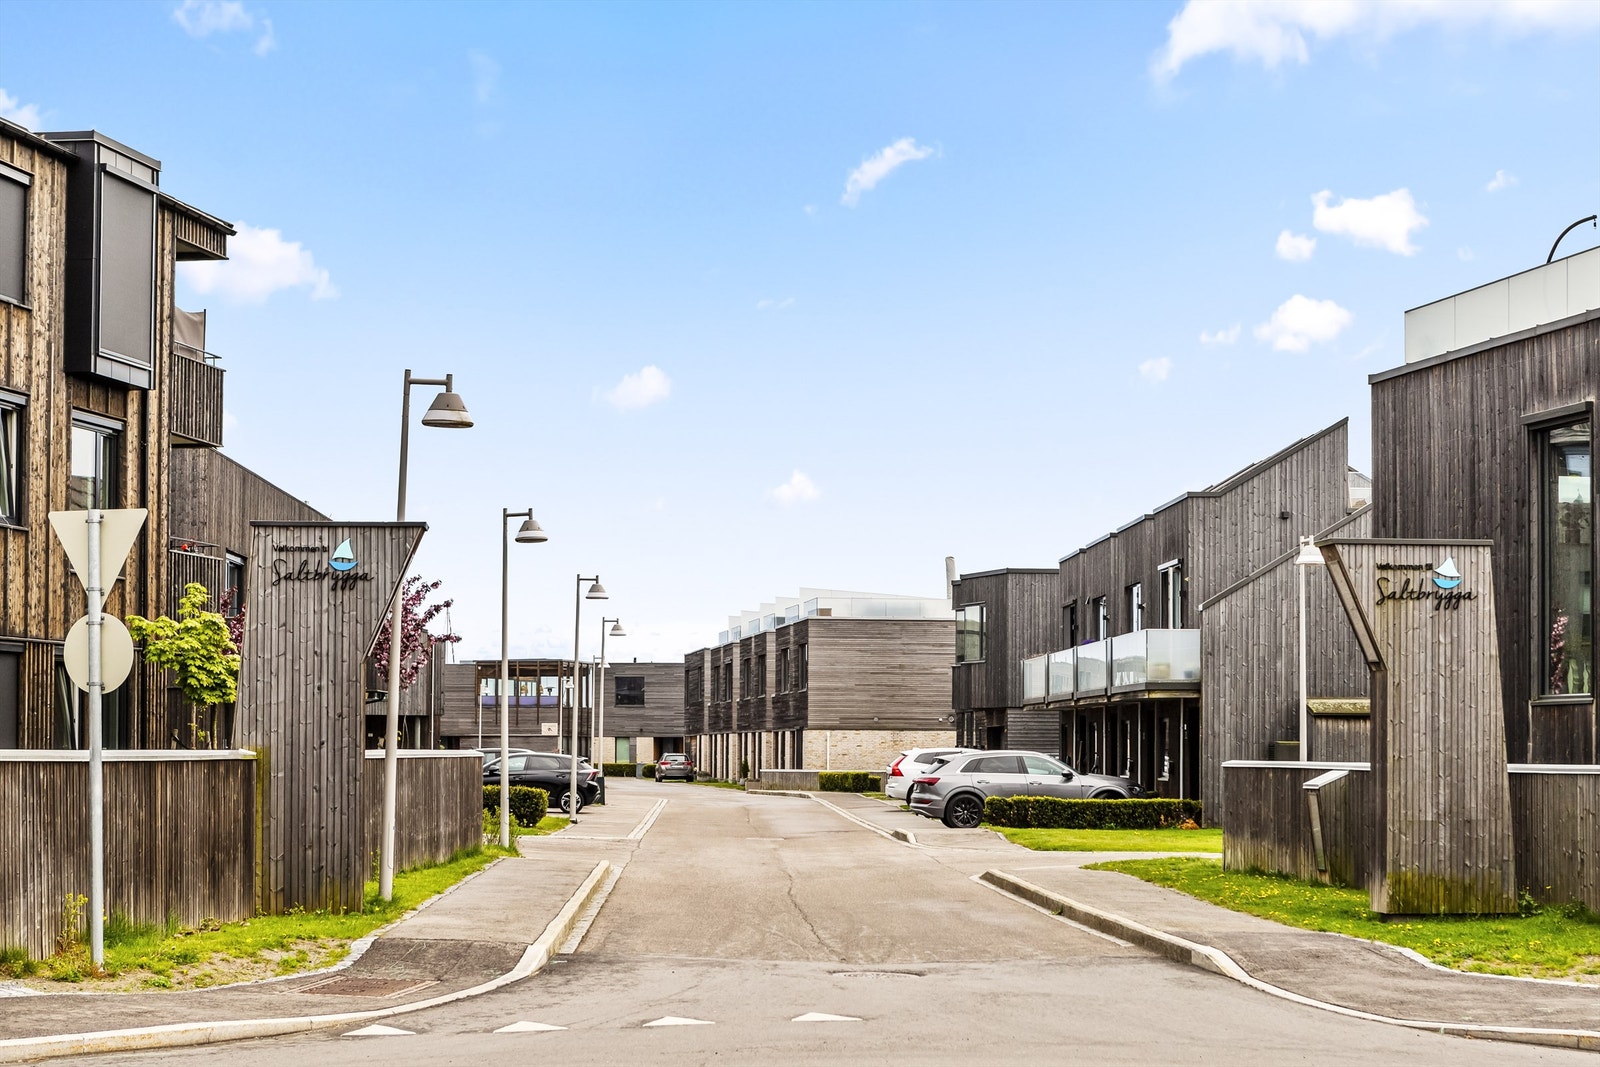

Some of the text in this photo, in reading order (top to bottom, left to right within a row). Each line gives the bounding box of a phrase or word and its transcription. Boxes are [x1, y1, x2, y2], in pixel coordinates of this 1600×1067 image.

[272, 544, 320, 552] Velkommen
[272, 559, 374, 591] Saltbrygga
[1376, 562, 1423, 570] Velkommen
[1376, 577, 1478, 610] Saltbrygga
